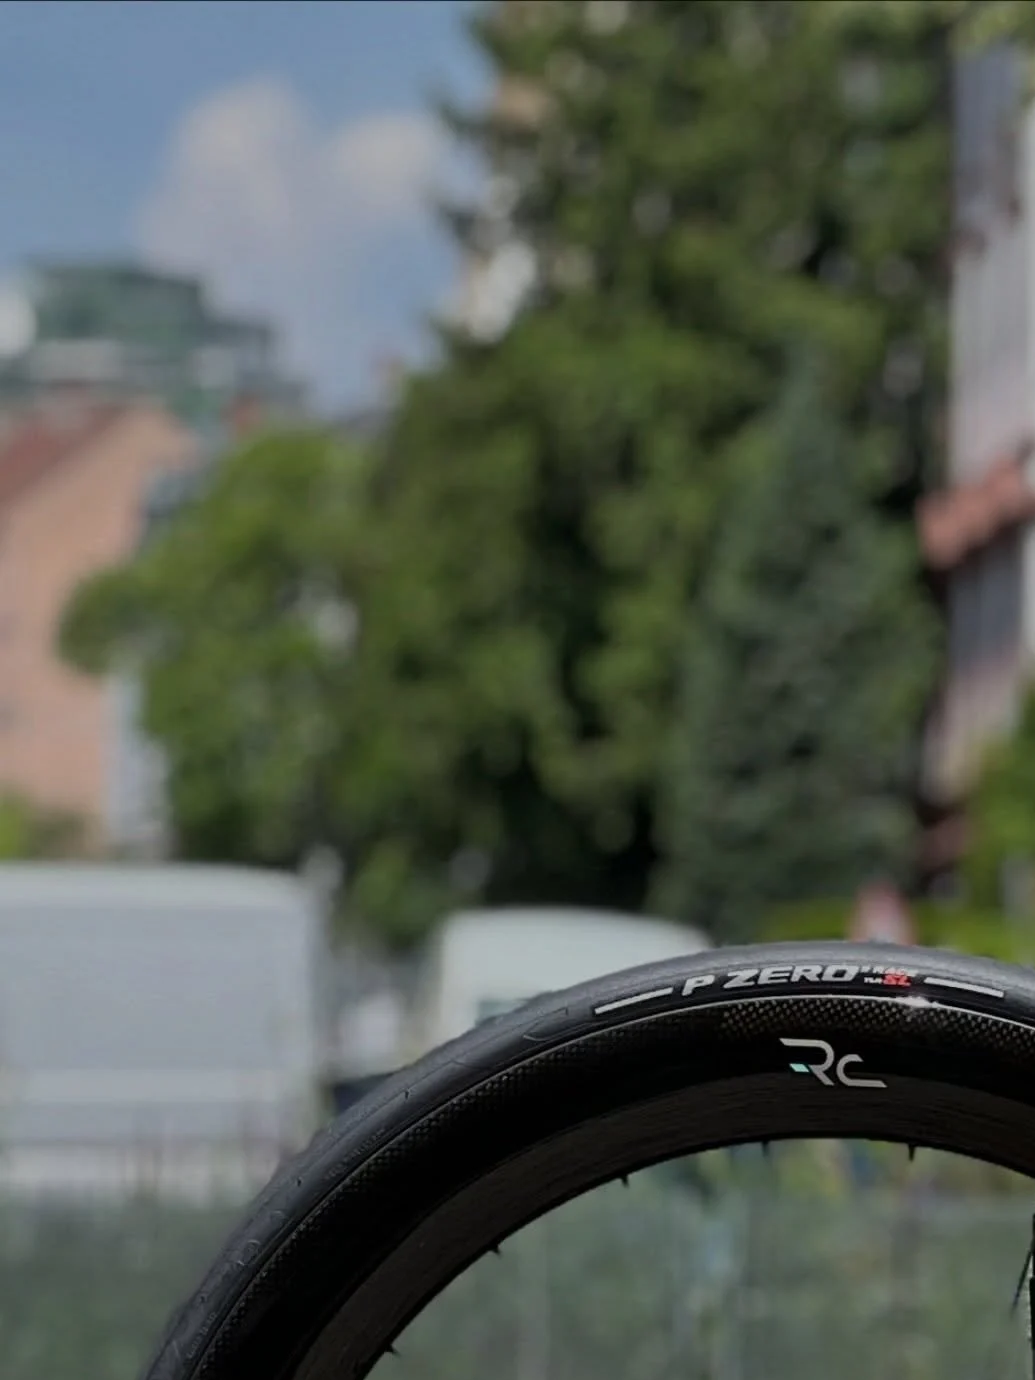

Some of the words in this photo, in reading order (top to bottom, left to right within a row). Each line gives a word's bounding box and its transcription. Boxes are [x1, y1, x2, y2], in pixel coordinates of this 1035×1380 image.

[681, 973, 716, 996] P
[722, 963, 861, 989] ZERO
[778, 1037, 888, 1089] RC
